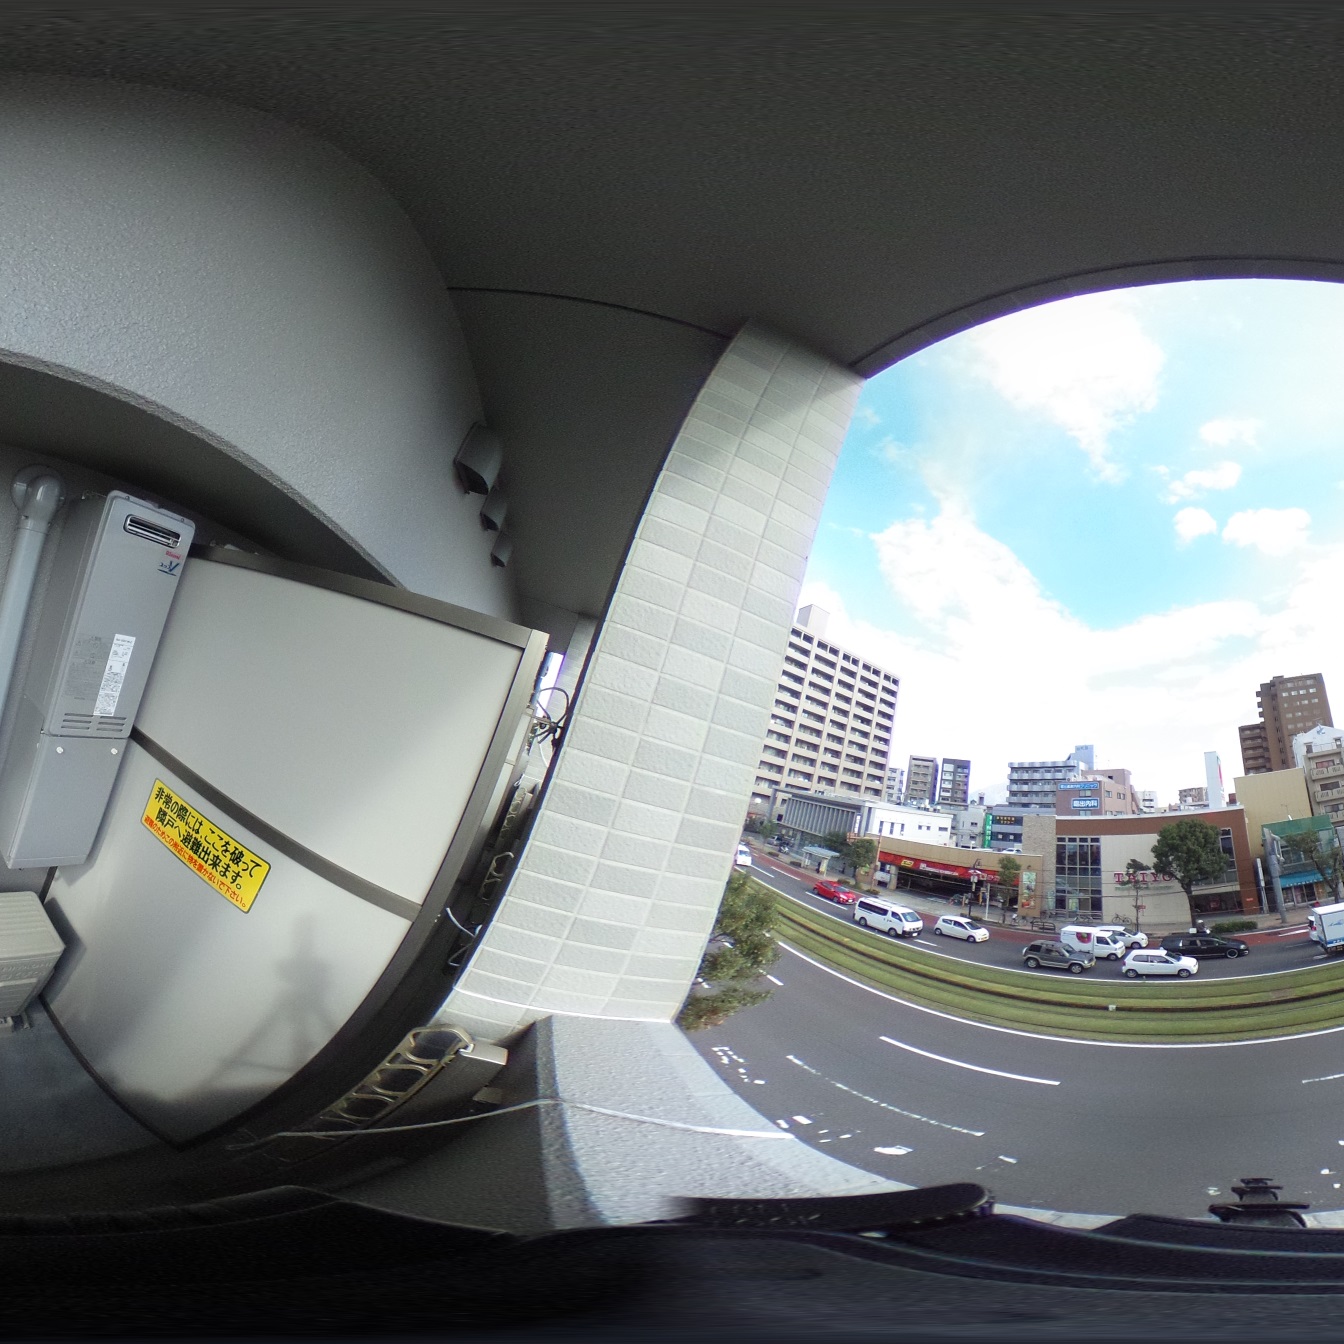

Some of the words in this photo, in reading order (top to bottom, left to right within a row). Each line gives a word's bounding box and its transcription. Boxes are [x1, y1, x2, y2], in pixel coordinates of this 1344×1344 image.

[155, 807, 242, 890] 隣戸へ避難出来ます。
[1114, 872, 1173, 884] TAIYO
